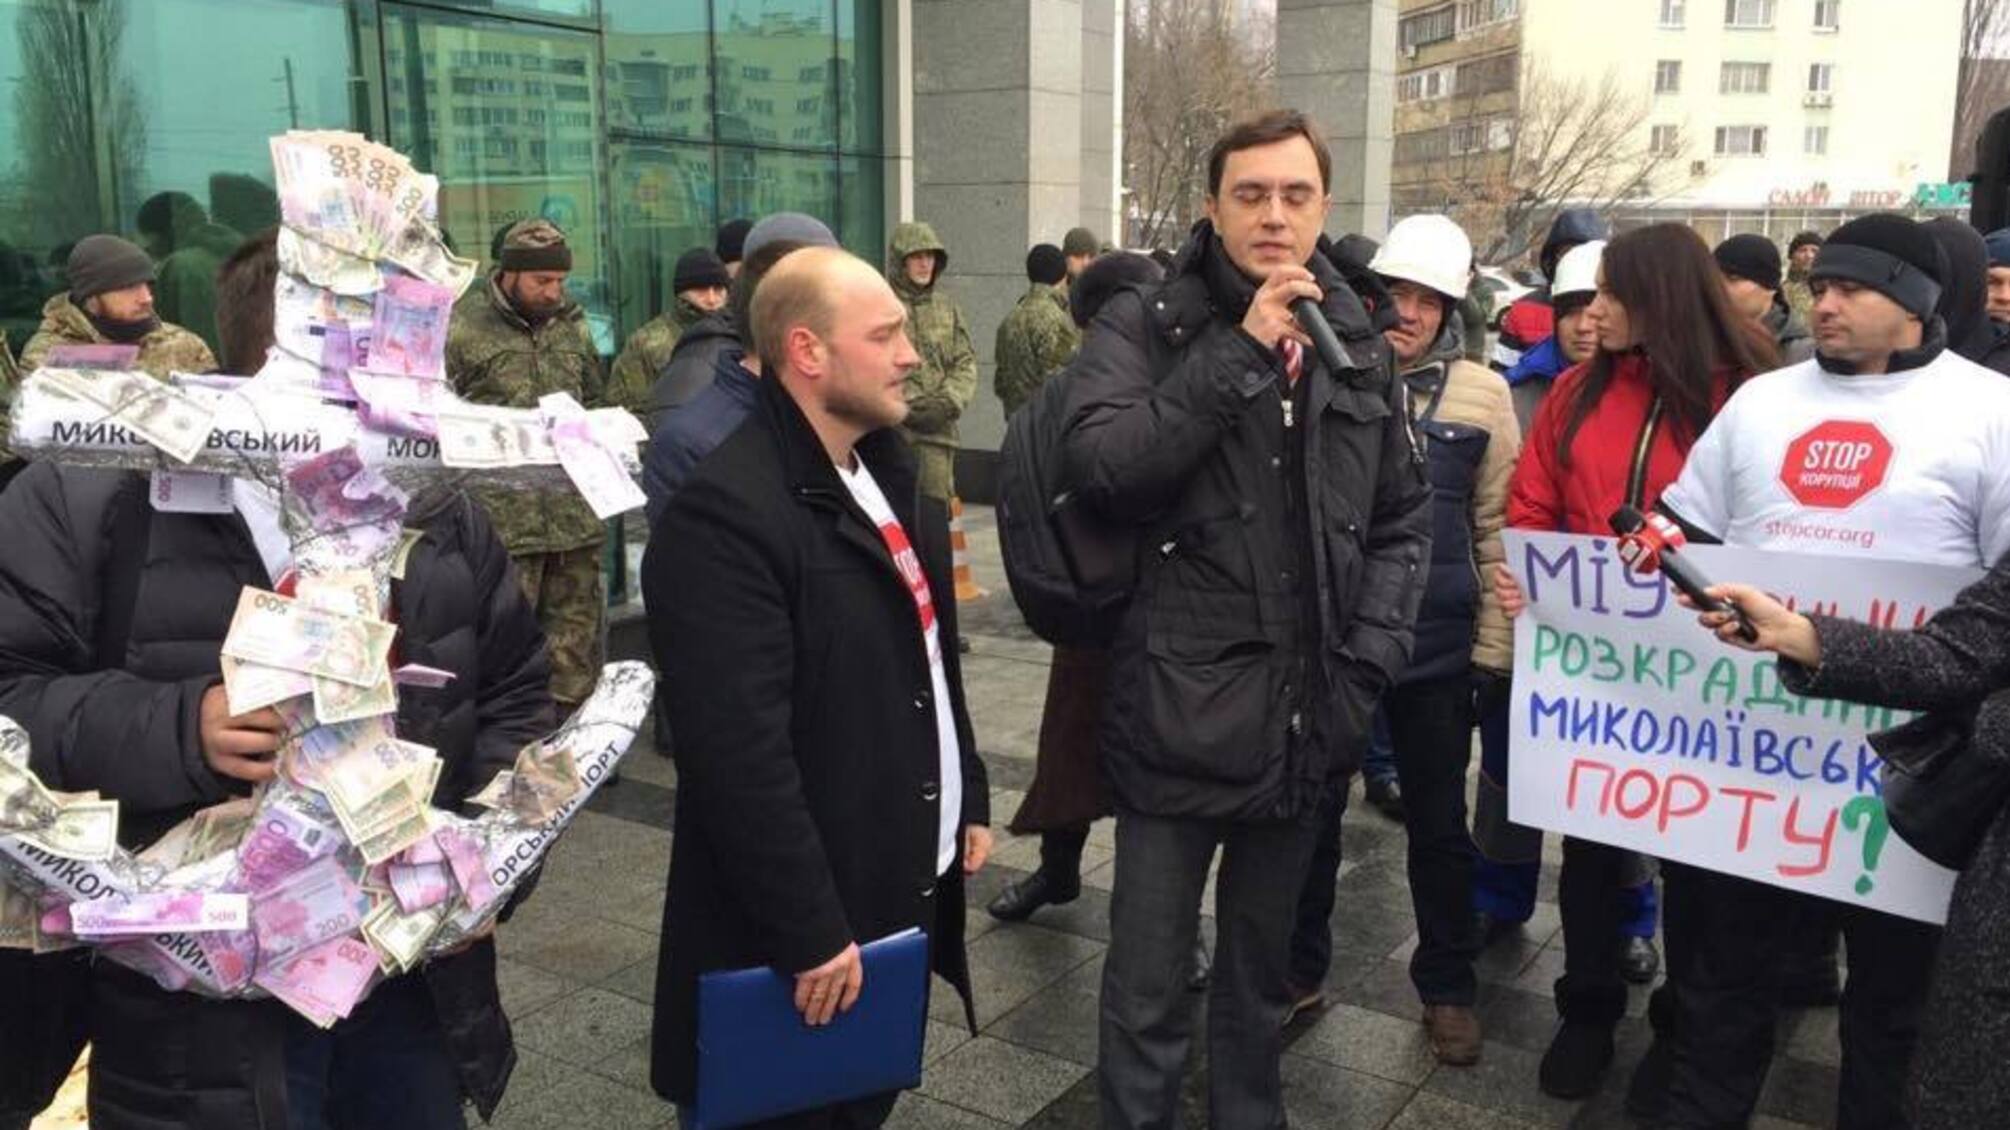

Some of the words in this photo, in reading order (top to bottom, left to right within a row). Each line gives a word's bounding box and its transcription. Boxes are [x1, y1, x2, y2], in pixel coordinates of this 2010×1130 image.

[51, 420, 321, 453] МИКВСЬКИЙ
[1804, 439, 1873, 470] STOP
[1765, 520, 1875, 548] stopcor.org
[1566, 758, 1891, 896] ПОРТУ?
